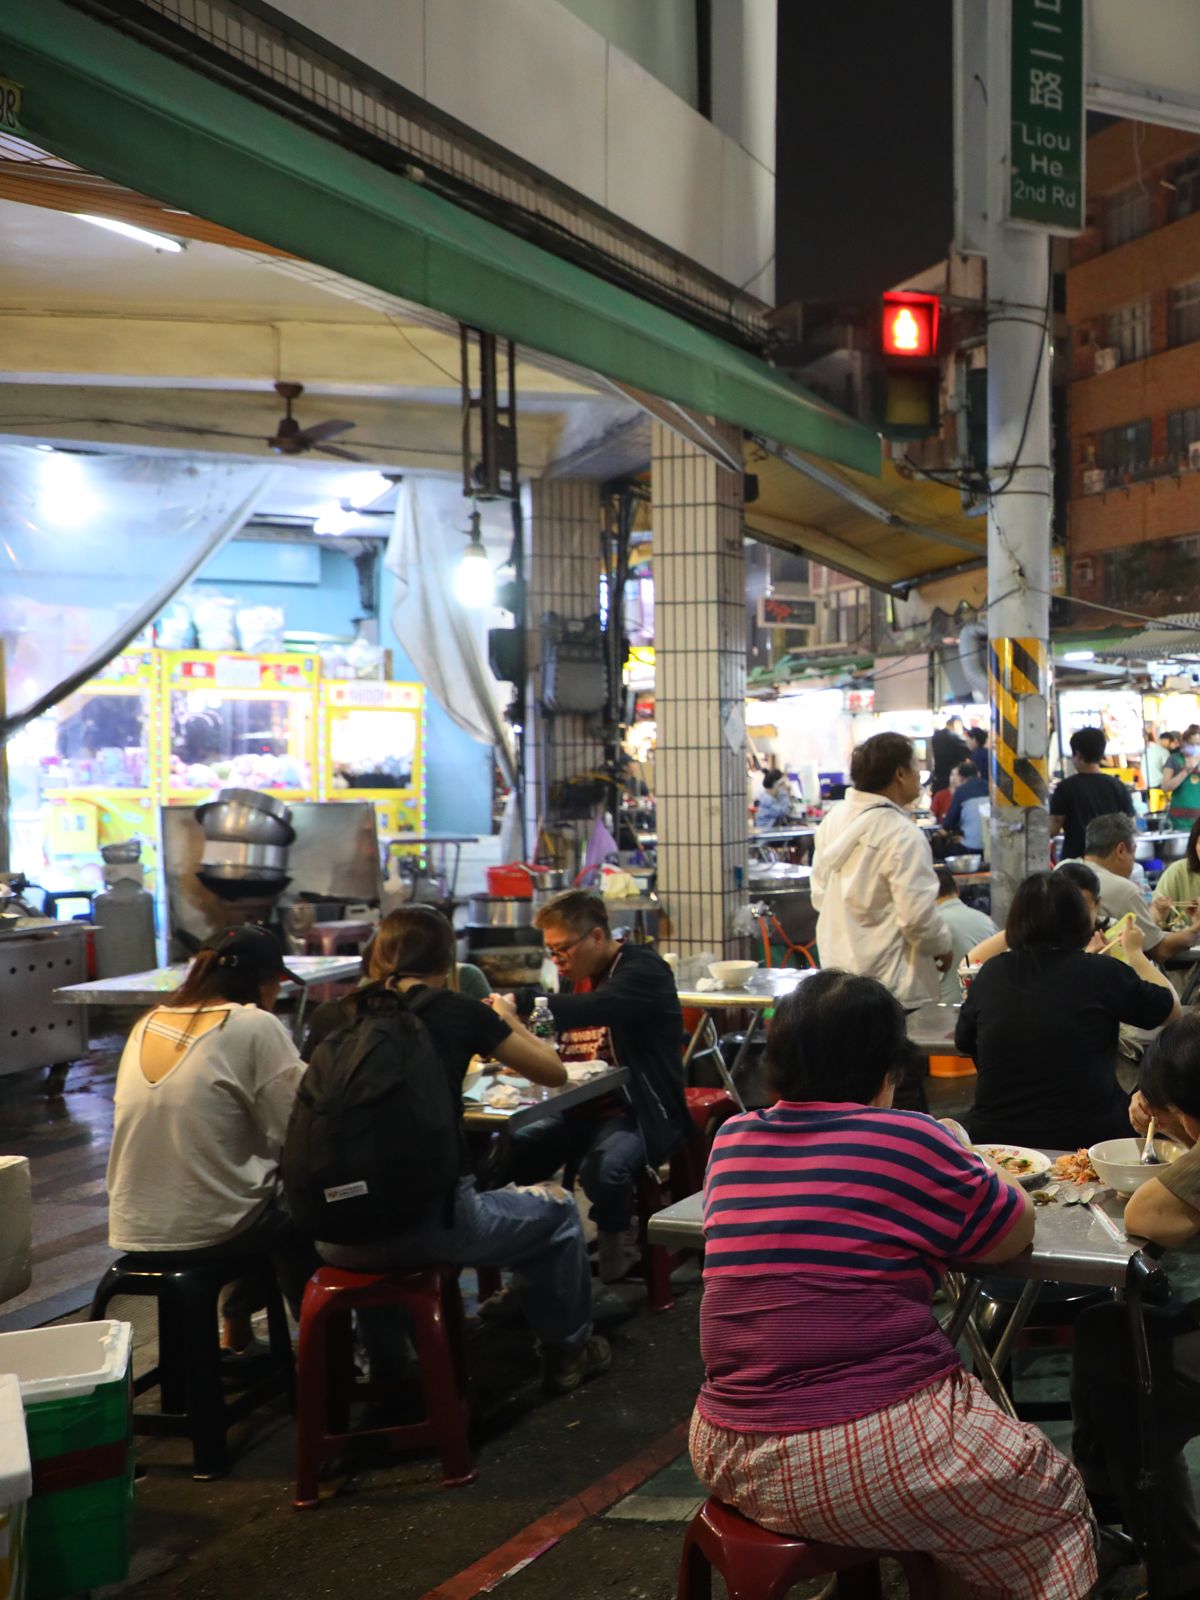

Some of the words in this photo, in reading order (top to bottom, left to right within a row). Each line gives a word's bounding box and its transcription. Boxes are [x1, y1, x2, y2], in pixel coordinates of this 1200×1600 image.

[1021, 122, 1071, 151] Liou
[1031, 153, 1063, 177] He
[1014, 179, 1046, 203] 2nd
[1052, 185, 1075, 208] Rd
